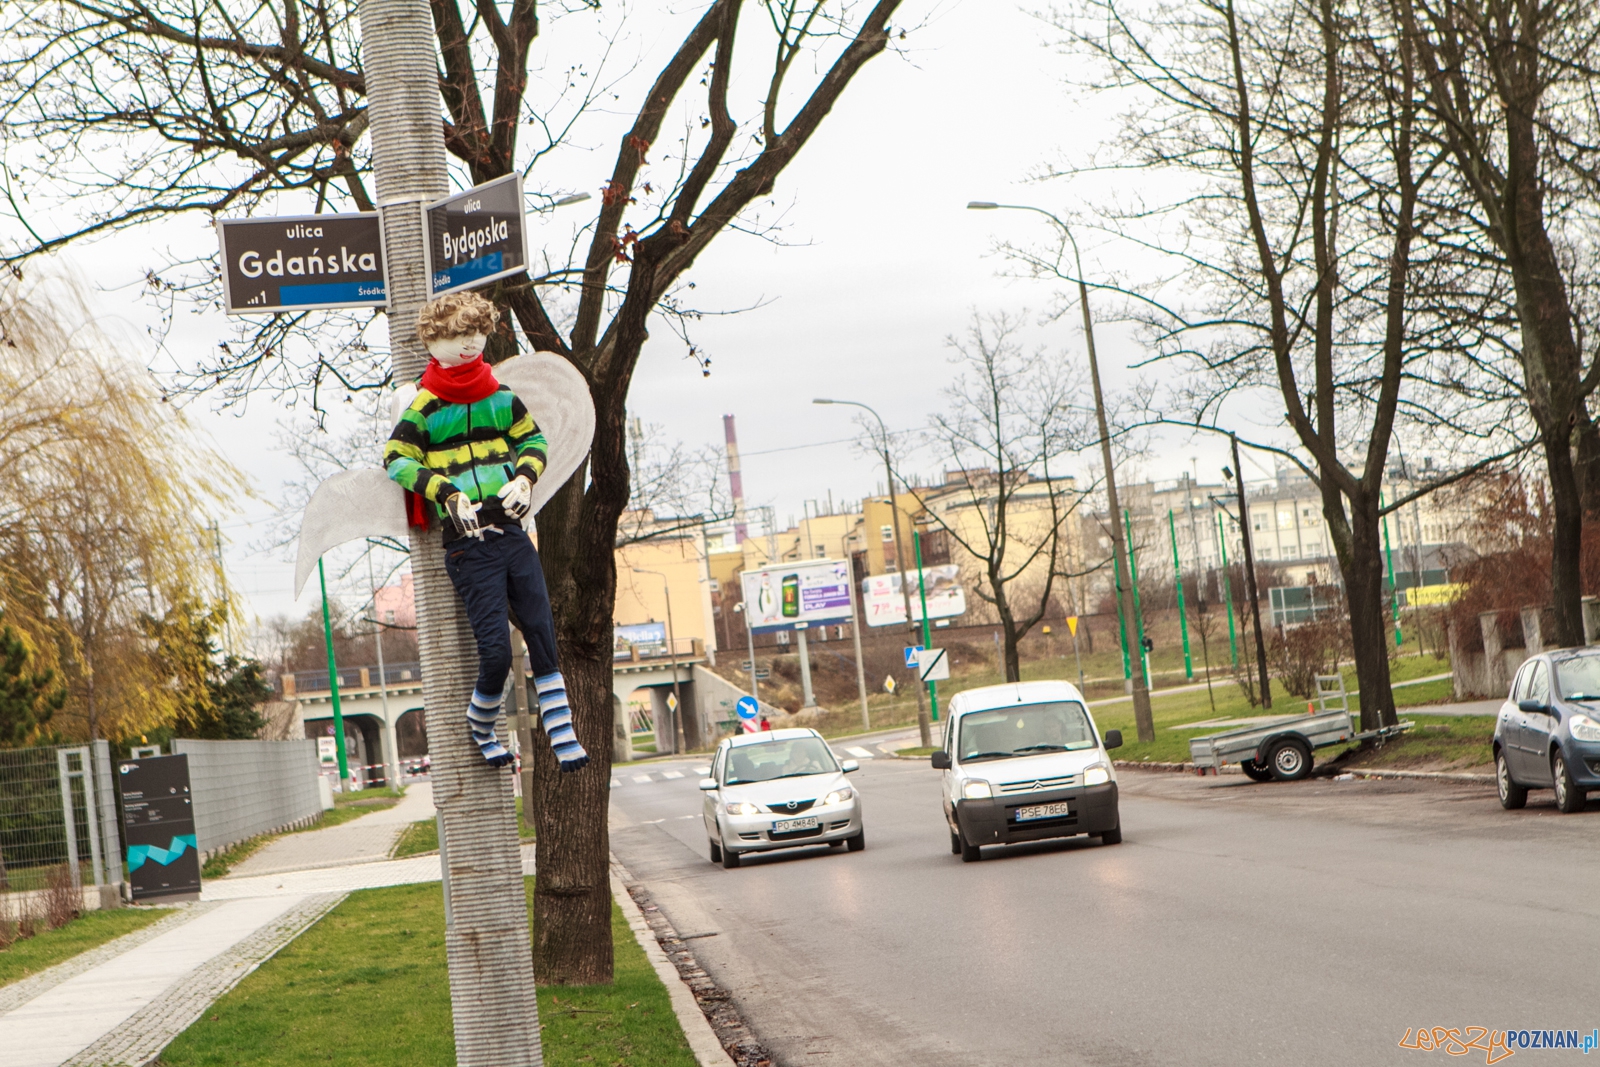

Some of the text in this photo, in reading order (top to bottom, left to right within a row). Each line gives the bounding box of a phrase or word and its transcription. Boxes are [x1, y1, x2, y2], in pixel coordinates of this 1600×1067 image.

[463, 198, 481, 214] ulica
[286, 224, 323, 239] ulica
[442, 216, 509, 265] Bydgoska
[238, 246, 377, 278] Gdańska
[433, 273, 451, 288] Śródka
[358, 285, 386, 296] Śródka
[1021, 803, 1067, 818] PSE 78EG
[777, 818, 816, 830] PO 4M848
